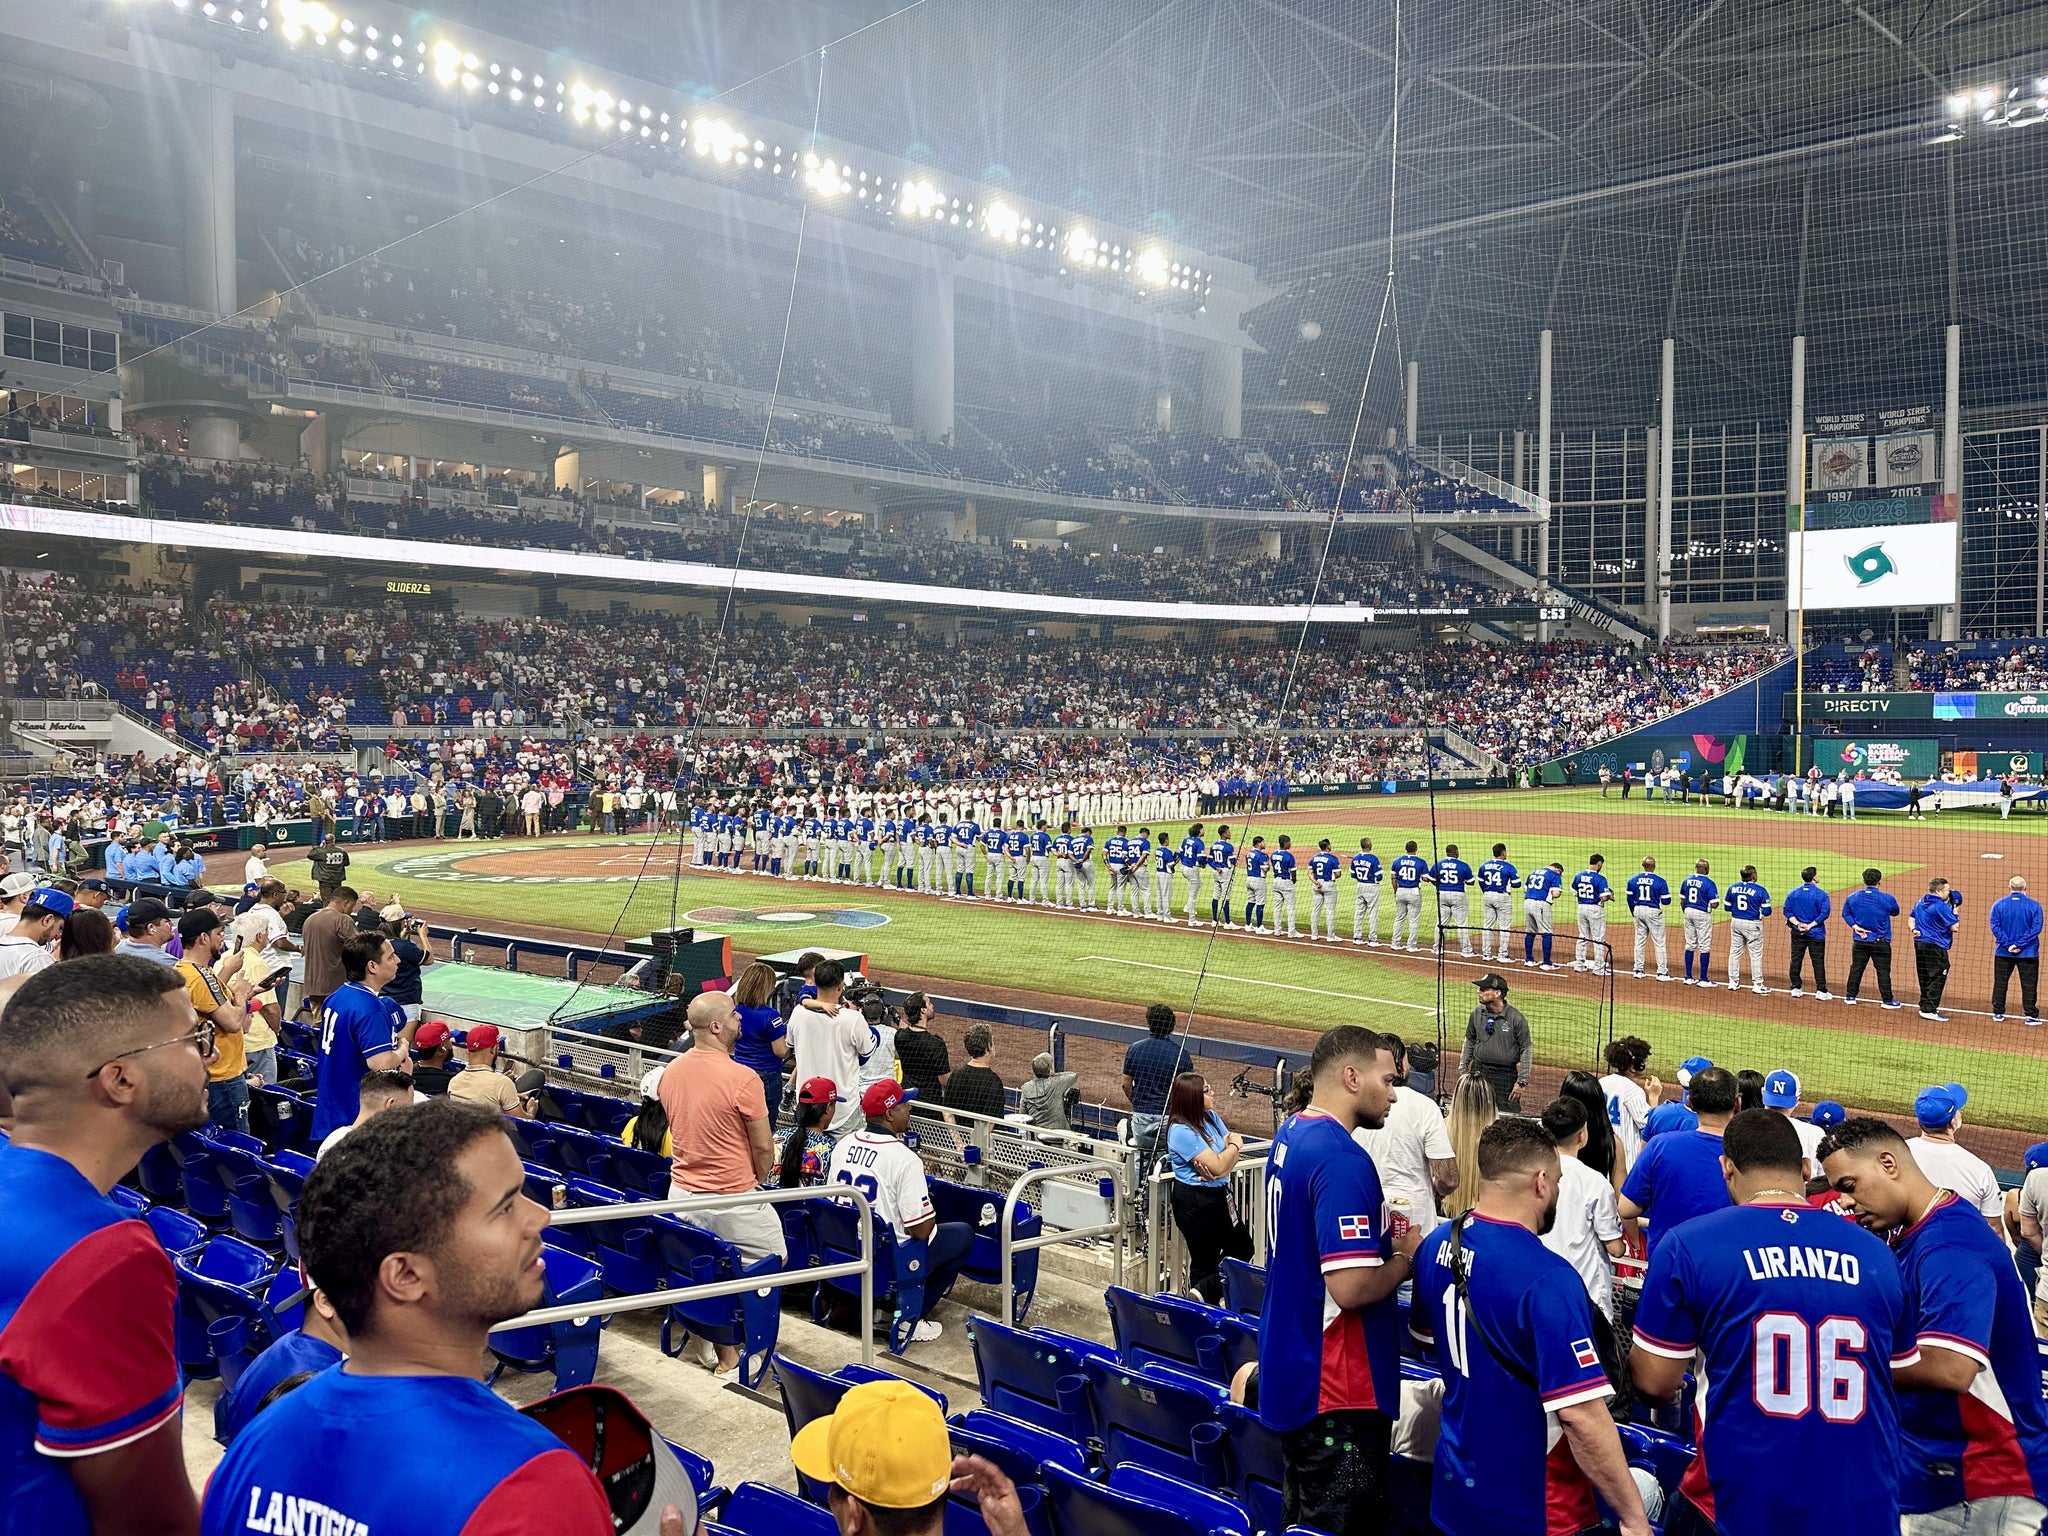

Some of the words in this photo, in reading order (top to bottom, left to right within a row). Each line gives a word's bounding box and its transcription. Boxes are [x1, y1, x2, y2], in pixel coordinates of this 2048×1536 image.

[1815, 415, 1839, 424] WORLD
[1841, 414, 1865, 422] SERIES
[1879, 409, 1905, 419] WORLD
[1907, 406, 1931, 416] SERIES
[1820, 422, 1860, 432] CHAMPIONS
[1884, 415, 1926, 427] CHAMPIONS
[1827, 491, 1853, 502] 1997
[1835, 500, 1908, 523] 2026
[386, 582, 422, 593] SLIDERZ
[1540, 608, 1566, 620] 6:53
[1583, 607, 1613, 631] LEVEL
[1824, 700, 1890, 712] DIRECTV
[17, 722, 46, 731] Miami
[49, 722, 86, 731] Marlins
[1582, 753, 1617, 775] 2026
[935, 832, 946, 844] 42
[959, 827, 969, 839] 41
[987, 838, 999, 850] 37
[1008, 840, 1020, 851] 32
[1032, 840, 1040, 851] 31
[1072, 842, 1085, 855] 27
[1109, 845, 1122, 858] 25
[1127, 845, 1141, 858] 24
[1184, 844, 1193, 859] 14
[1213, 851, 1223, 863] 10
[1247, 858, 1253, 871] 5
[1274, 861, 1282, 874] 4
[1316, 863, 1324, 876] 2
[1355, 867, 1370, 880] 67
[1398, 866, 1416, 881] 40
[1440, 869, 1459, 884] 35
[1484, 871, 1502, 886] 34
[1528, 875, 1545, 890] 33
[1636, 877, 1655, 886] JONES
[1577, 883, 1594, 900] 22
[1639, 885, 1651, 901] 11
[1688, 887, 1698, 903] 8
[35, 893, 49, 905] N
[1737, 894, 1748, 911] 6
[321, 1007, 339, 1056] 14
[1772, 1080, 1786, 1095] N
[845, 1145, 878, 1168] SOTO
[1435, 1239, 1476, 1278] ARPA
[1743, 1246, 1860, 1286] LIRANZO
[1442, 1283, 1470, 1379] 11
[1752, 1310, 1868, 1424] 06
